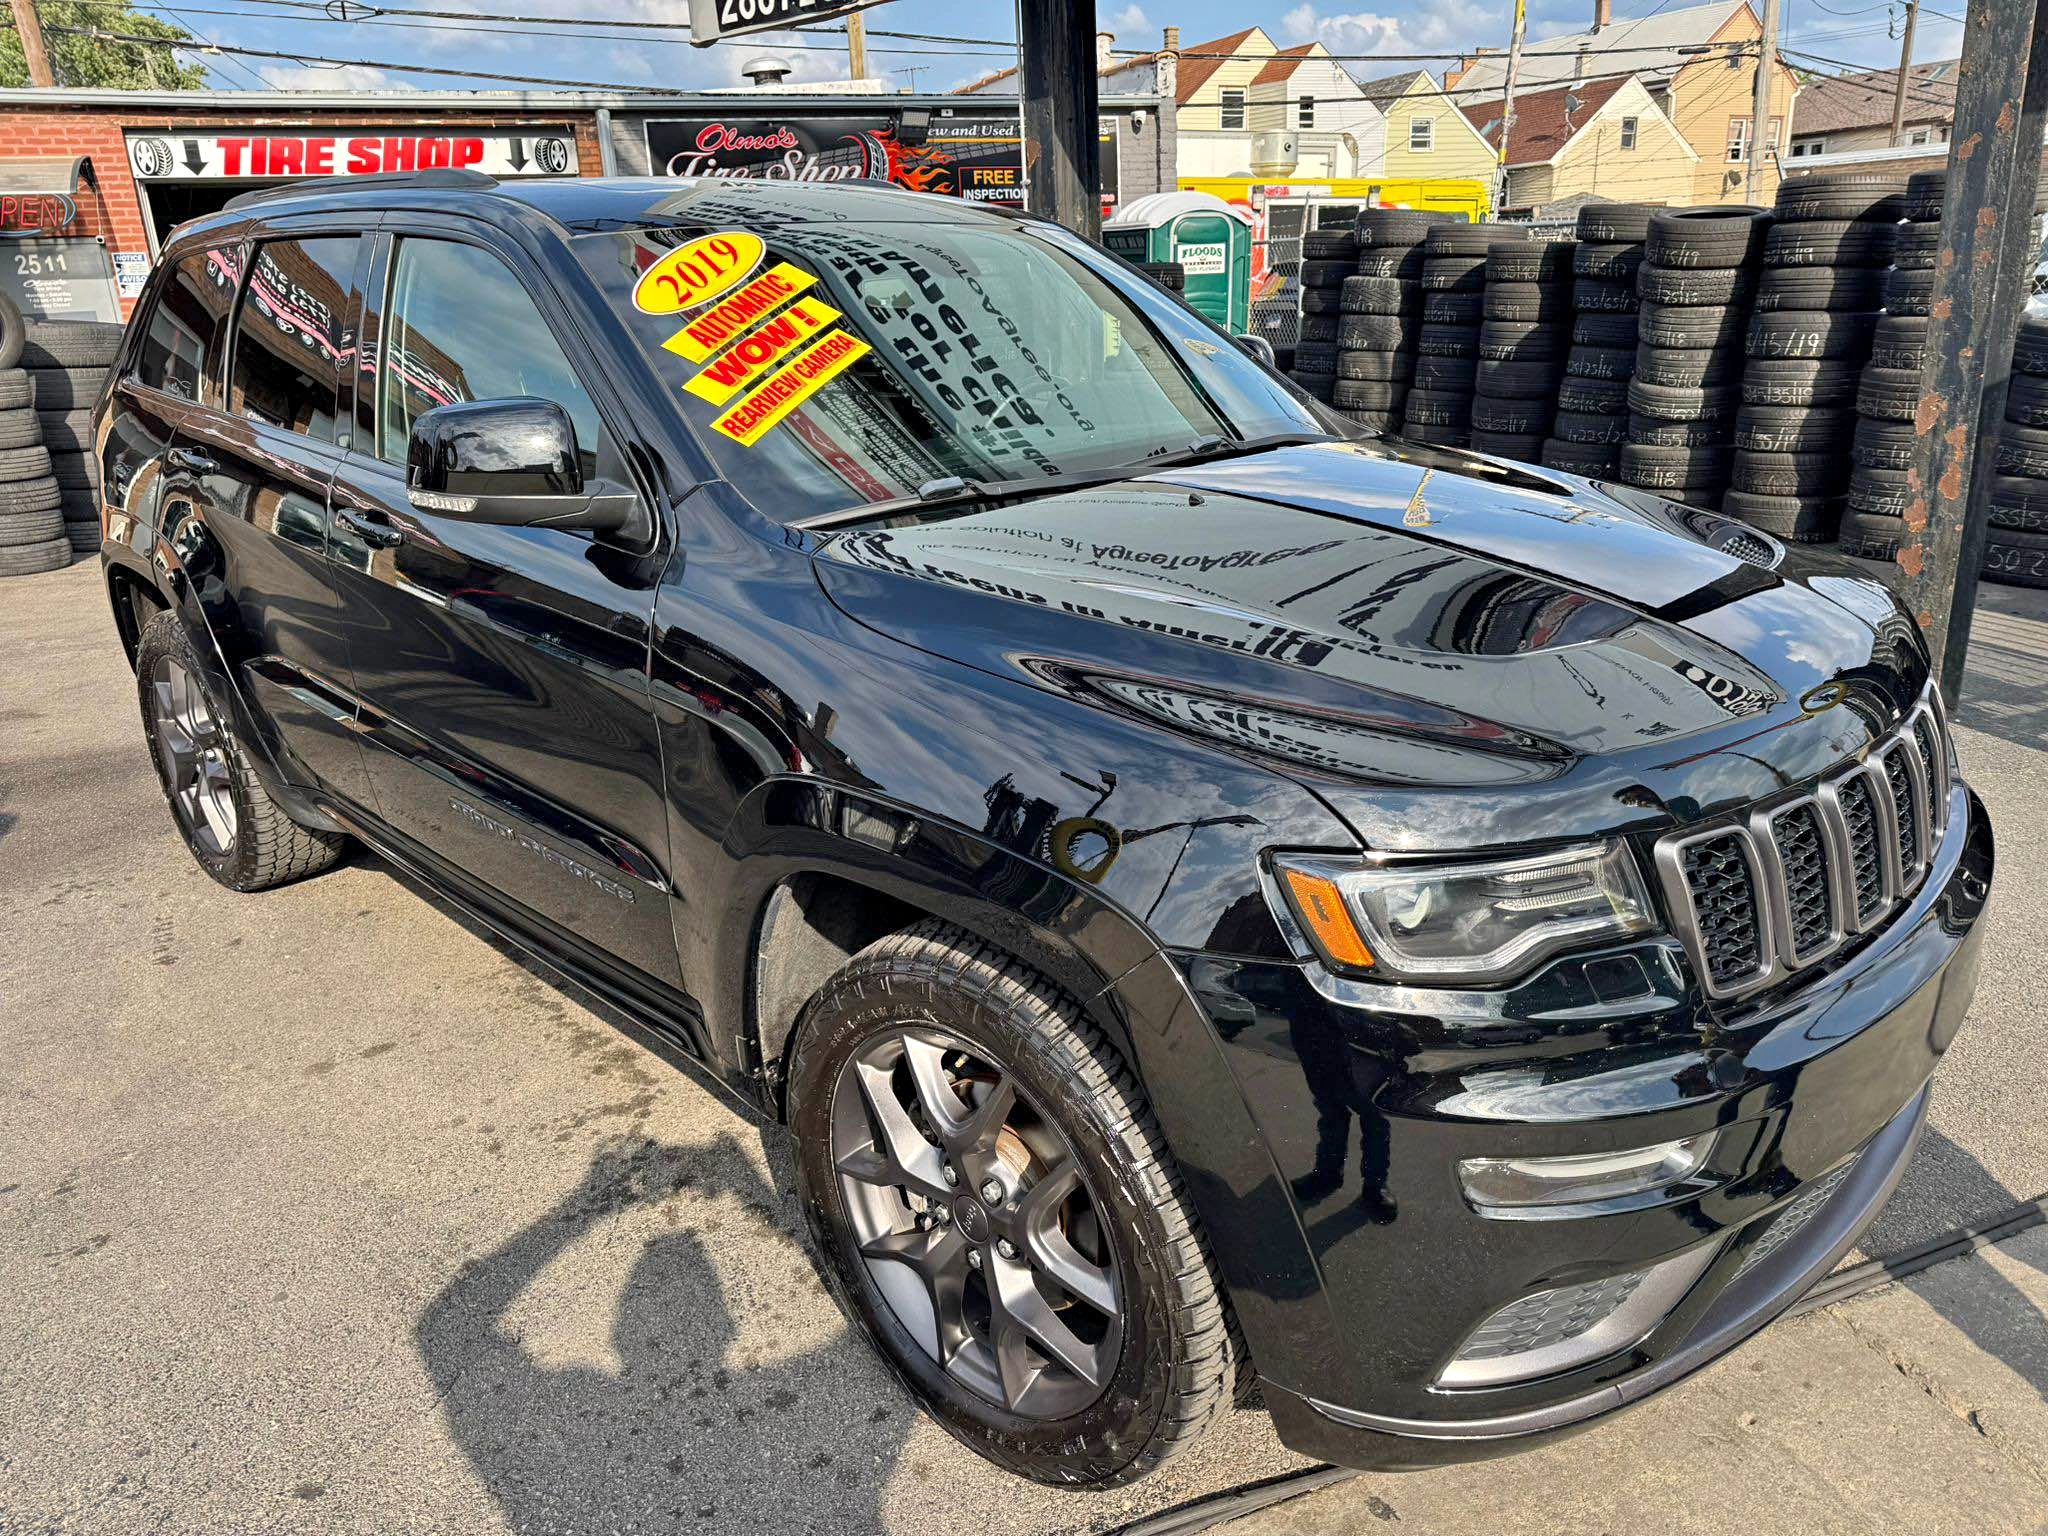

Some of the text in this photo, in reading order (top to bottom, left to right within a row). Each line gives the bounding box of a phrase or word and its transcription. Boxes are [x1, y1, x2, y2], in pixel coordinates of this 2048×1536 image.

[695, 123, 799, 151] Olmo's
[928, 125, 948, 136] ew
[951, 125, 977, 136] and
[981, 125, 1014, 136] Used
[216, 137, 485, 175] TIRE SHOP
[666, 149, 863, 182] Tire Shop
[973, 169, 1015, 185] FREE
[962, 188, 1029, 200] INSPECTION
[0, 196, 58, 227] PEN
[14, 253, 67, 275] 2511
[116, 254, 143, 262] NOTICE
[1182, 246, 1223, 258] FLOODS
[121, 275, 147, 283] AVISO
[656, 238, 740, 305] 2019
[686, 272, 798, 350] AUTOMATIC
[703, 315, 801, 387] WOW
[721, 370, 804, 438] REARVIEW
[793, 334, 857, 380] CAMERA
